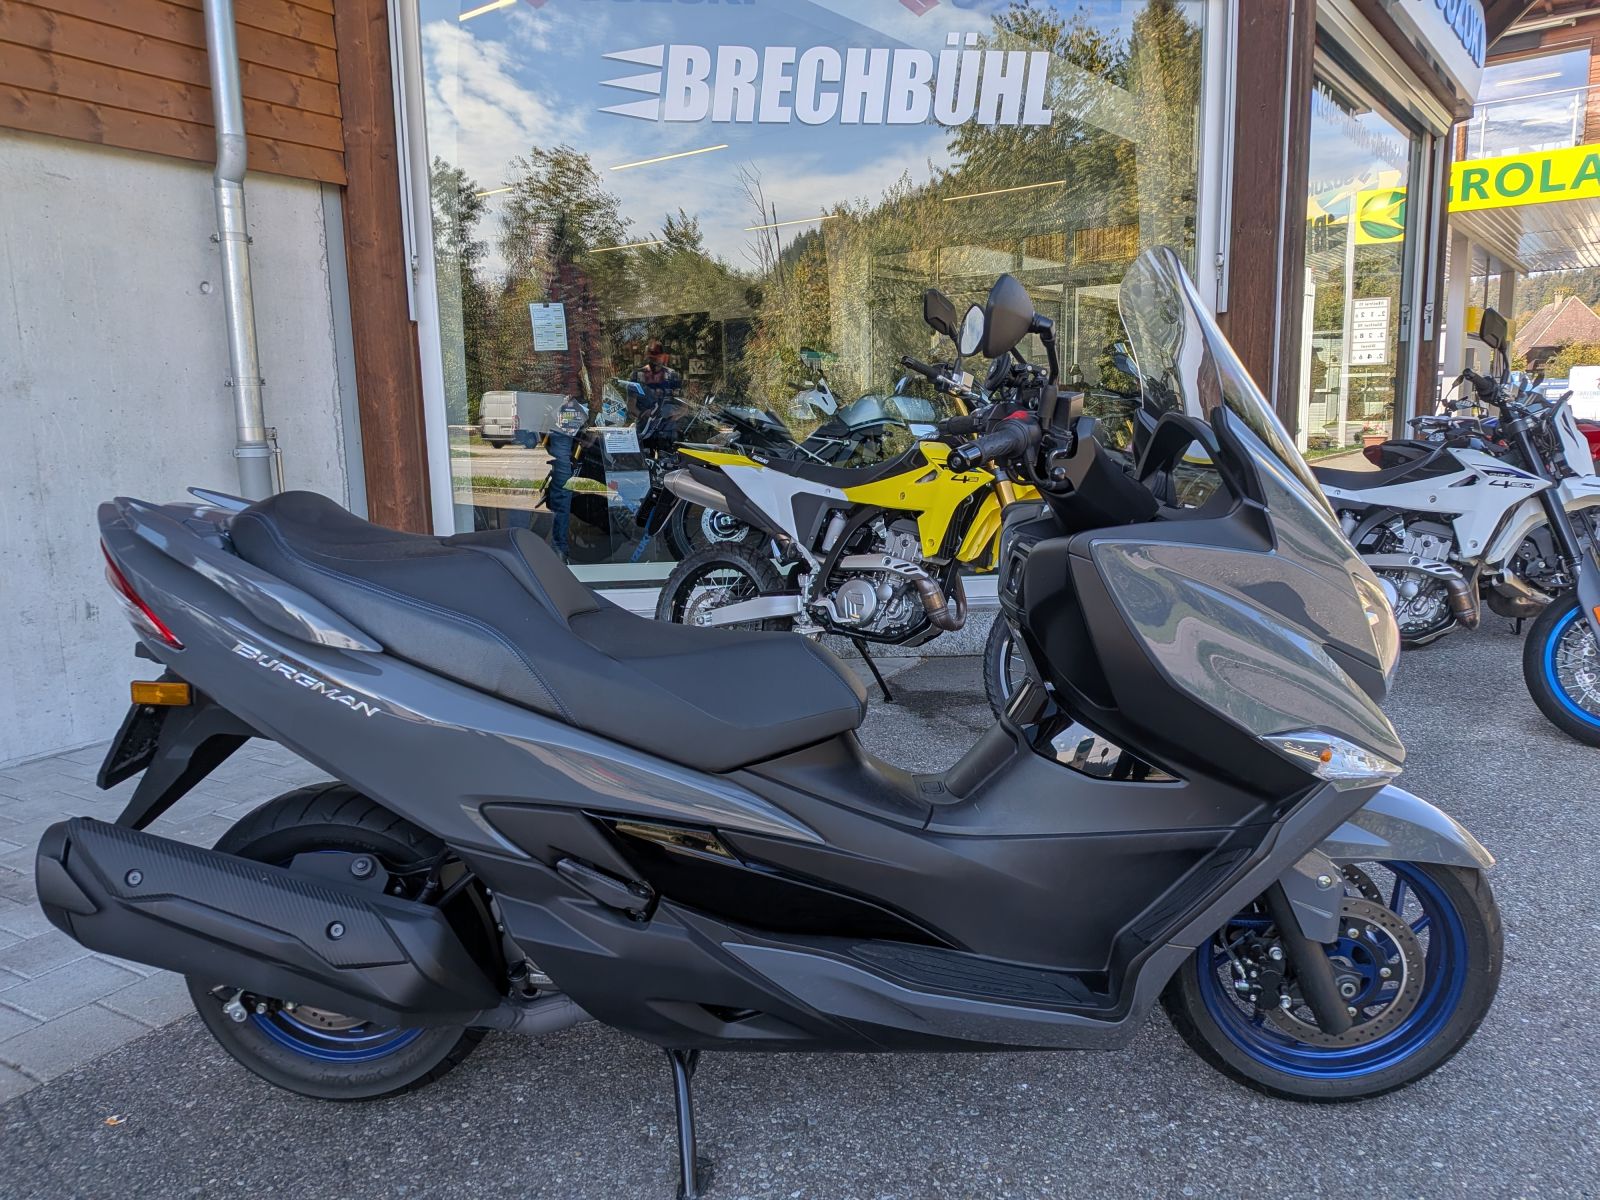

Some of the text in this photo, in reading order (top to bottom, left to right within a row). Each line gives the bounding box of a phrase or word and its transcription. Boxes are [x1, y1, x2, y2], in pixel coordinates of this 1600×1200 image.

[1434, 0, 1484, 68] UZUKI
[664, 33, 1052, 126] BRECHBÜHL
[1448, 153, 1600, 203] ROLA
[232, 640, 381, 717] BURGMAN
